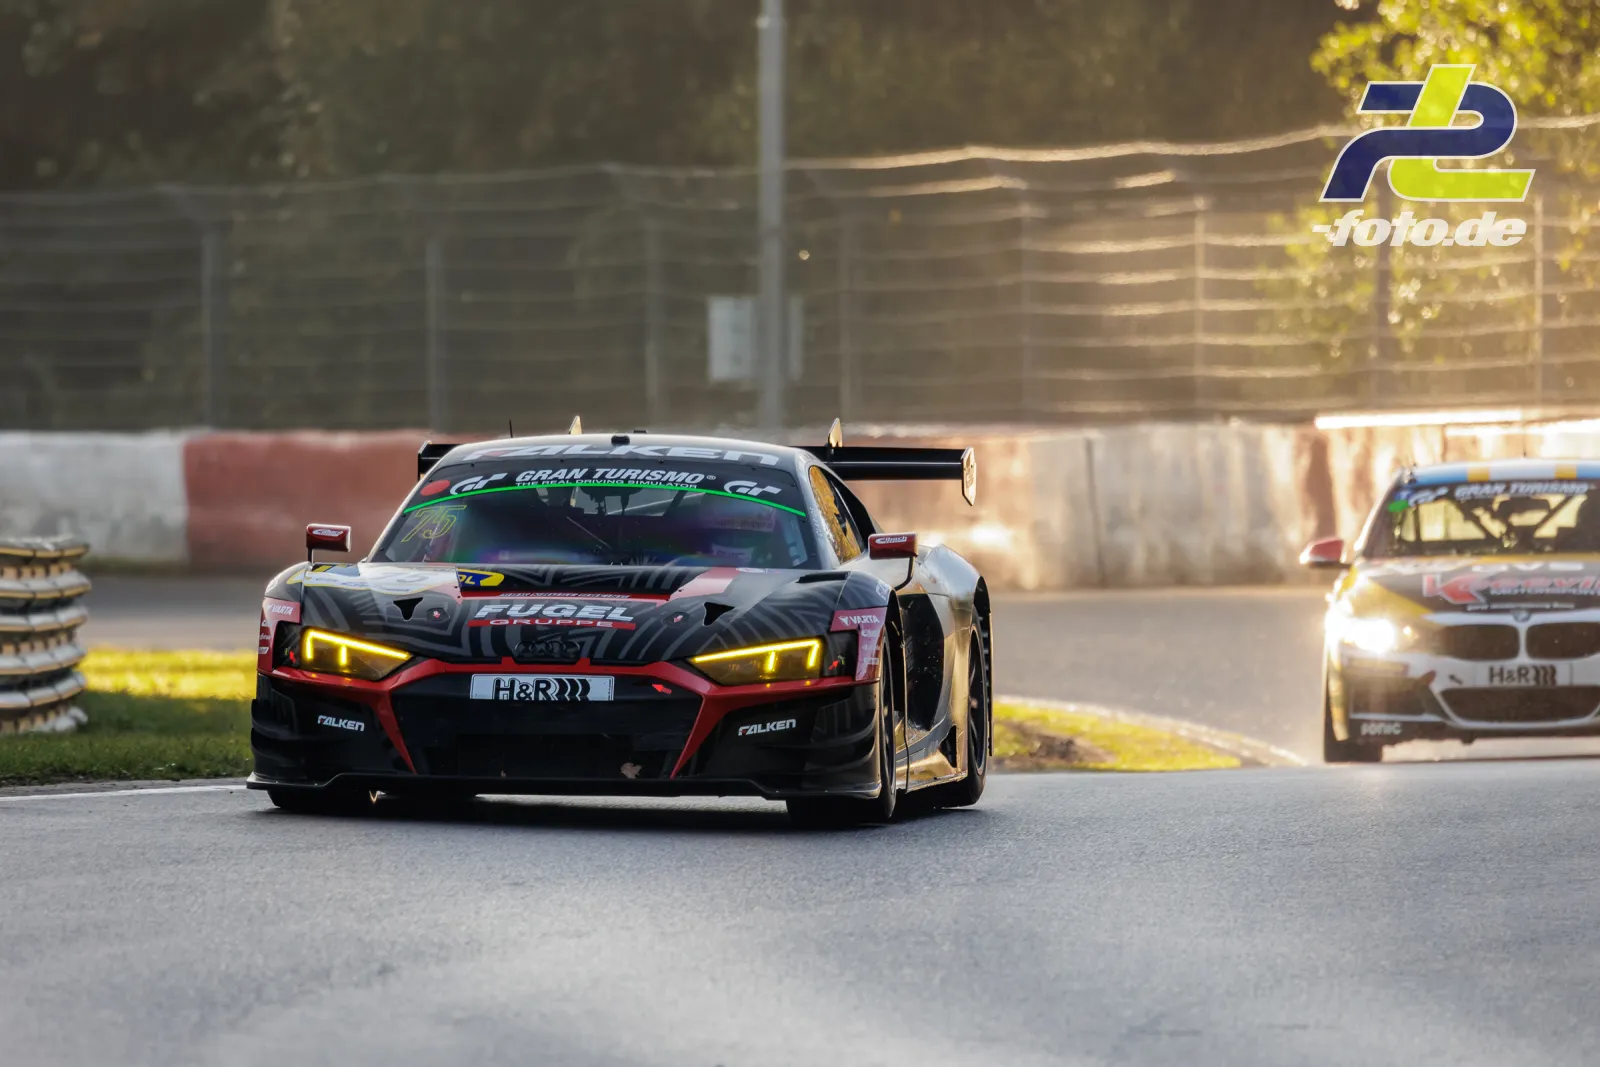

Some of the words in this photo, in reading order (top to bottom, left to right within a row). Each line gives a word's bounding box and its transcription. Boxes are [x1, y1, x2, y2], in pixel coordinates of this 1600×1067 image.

[462, 445, 779, 465] FALKEN
[516, 468, 588, 482] GRAN
[627, 480, 697, 489] SIMULATOR
[401, 504, 467, 542] 75
[272, 604, 293, 616] VARTA
[474, 604, 634, 622] FUGEL
[490, 619, 613, 628] GRUPPE
[849, 614, 880, 625] VARTA
[317, 715, 365, 731] FALKEN
[738, 719, 796, 736] FALKEN
